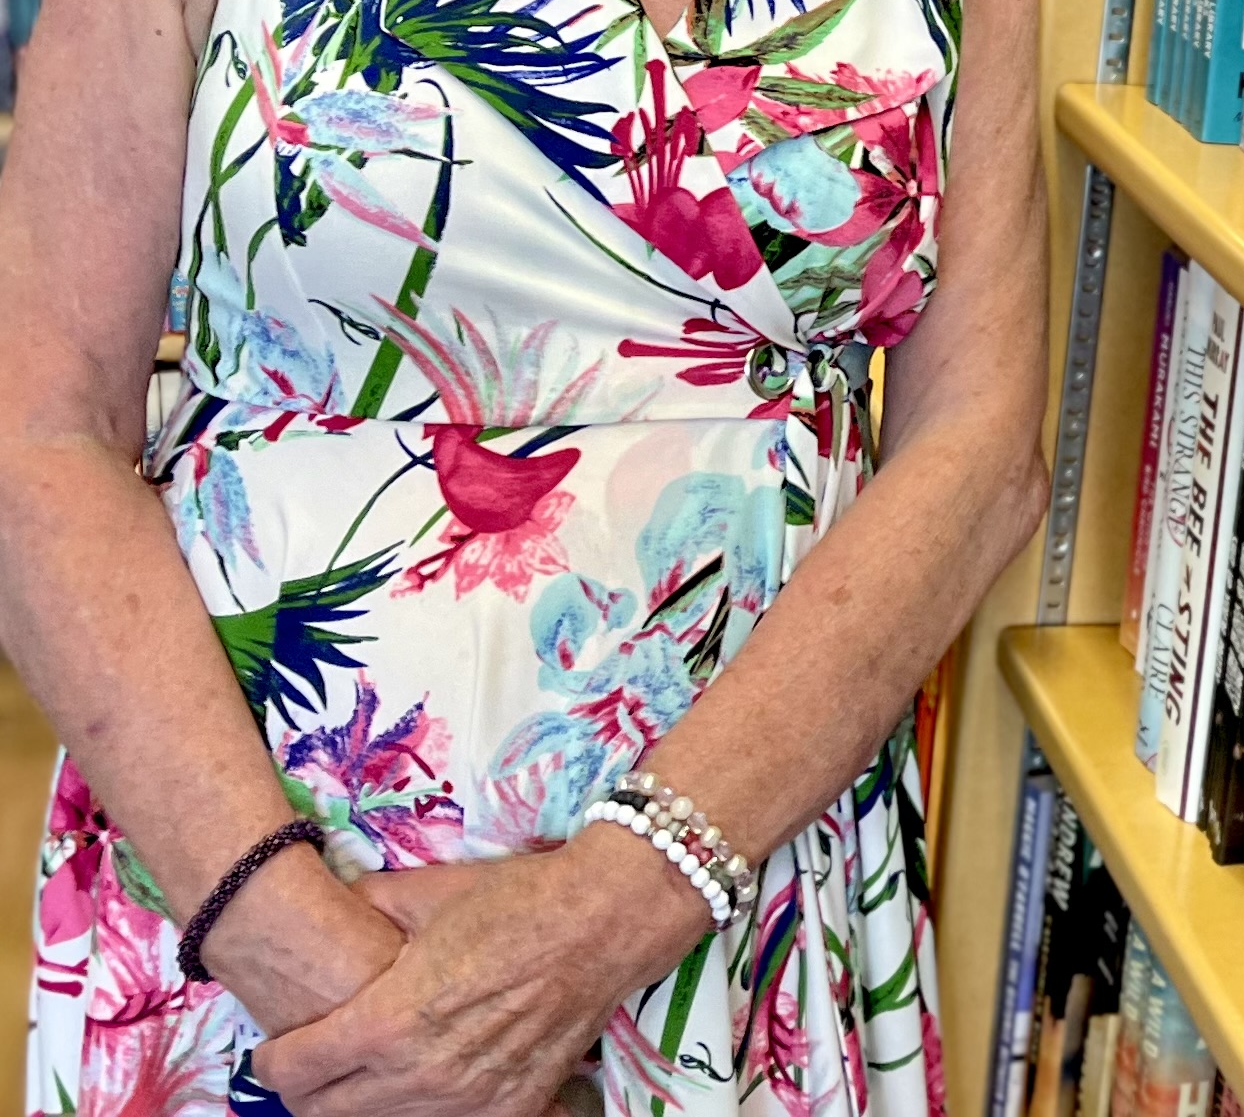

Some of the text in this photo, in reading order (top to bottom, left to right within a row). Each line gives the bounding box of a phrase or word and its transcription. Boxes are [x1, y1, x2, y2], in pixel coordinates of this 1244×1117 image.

[1148, 332, 1171, 449] MURAKAMI
[1166, 347, 1207, 546] THIS STRANGE
[1166, 391, 1220, 726] THE BEE STING
[1148, 603, 1172, 703] CLAIRE
[1123, 969, 1145, 1022] WILD
[1143, 970, 1166, 1060] A WILD
